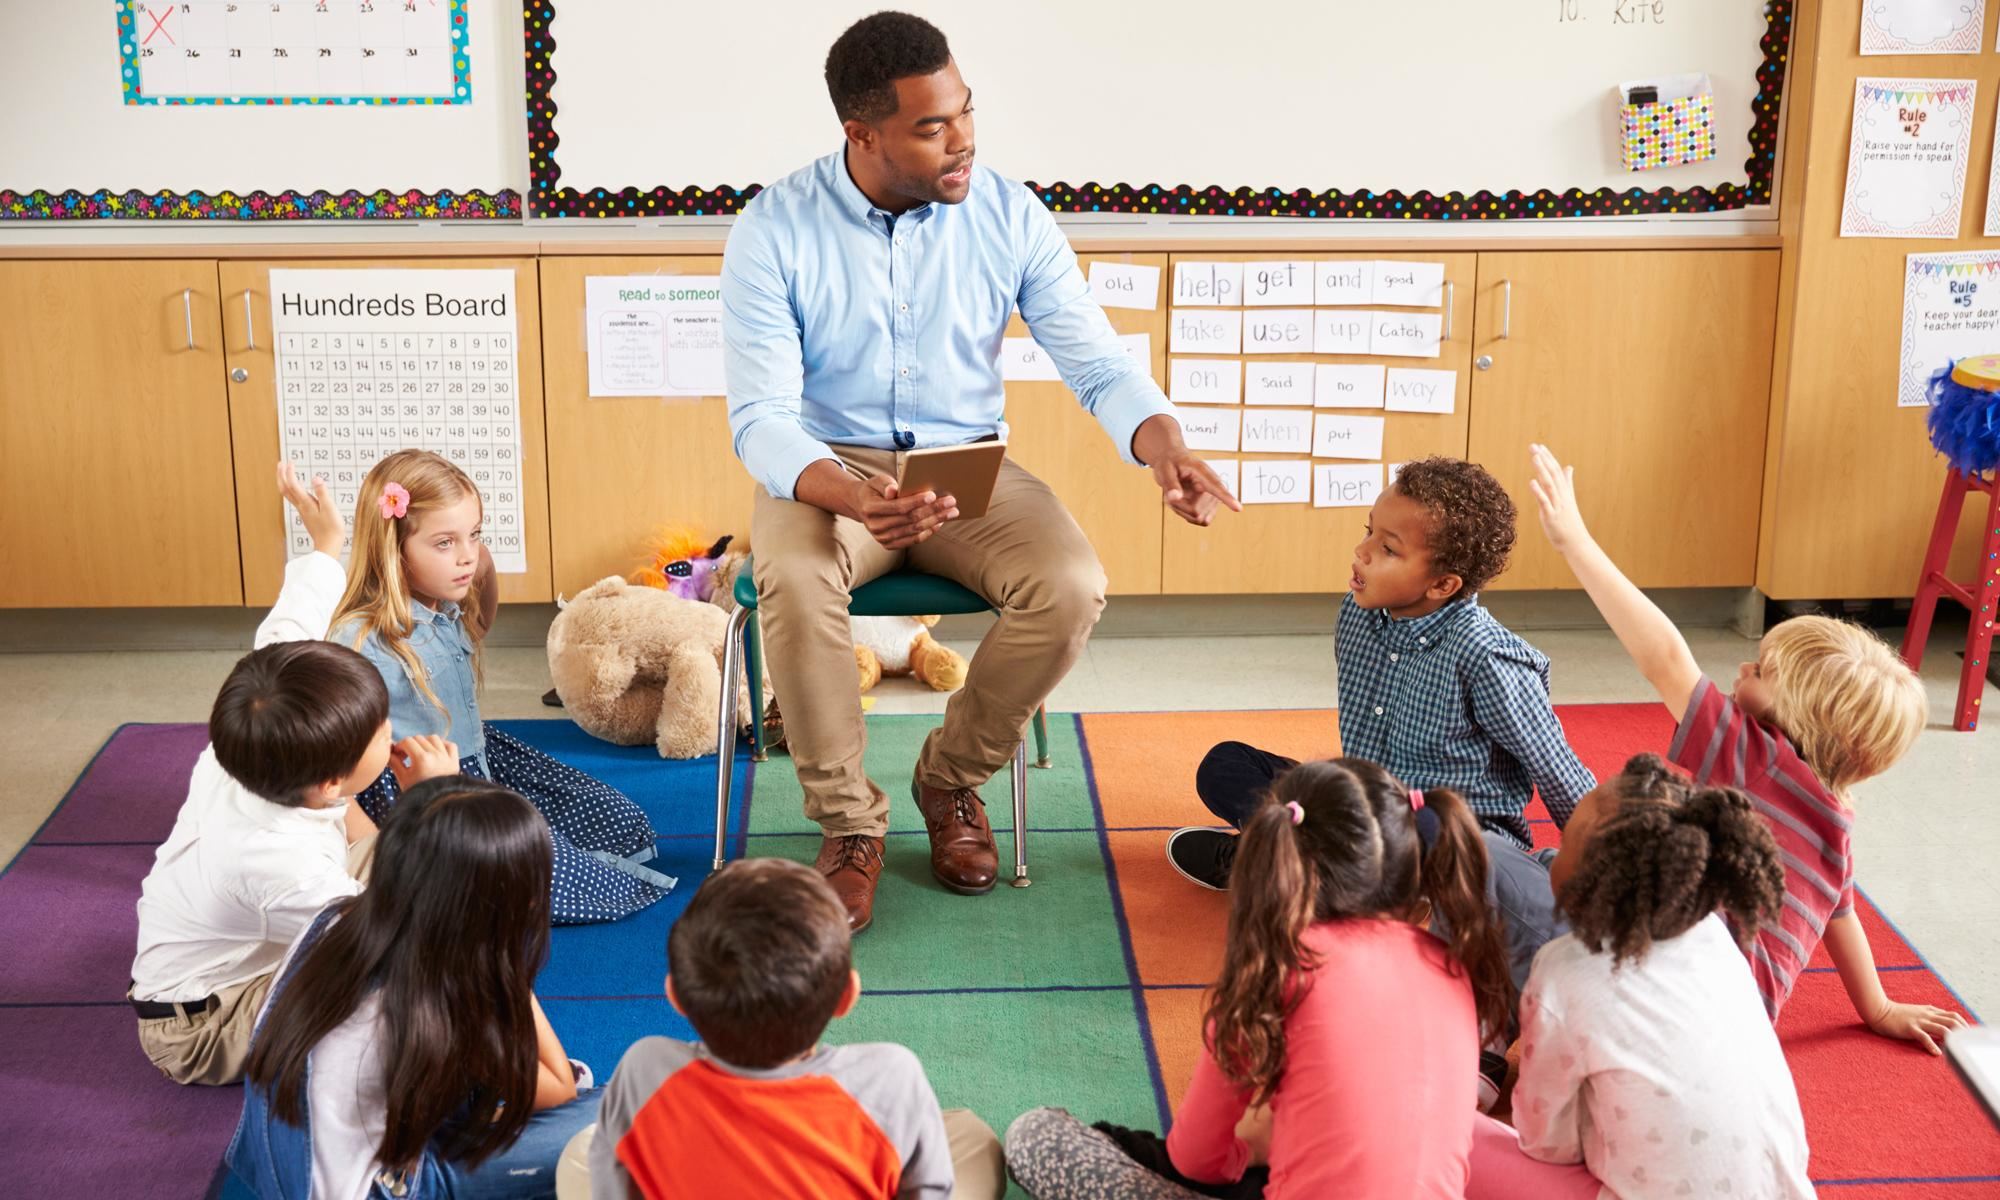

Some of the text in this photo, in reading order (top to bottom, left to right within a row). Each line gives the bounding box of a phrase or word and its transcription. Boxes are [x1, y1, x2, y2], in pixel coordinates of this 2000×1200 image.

[181, 5, 190, 13] 19
[361, 49, 375, 57] 30
[1899, 108, 1927, 122] Rule
[1904, 123, 1920, 137] #2
[1866, 141, 1954, 151] Raise your hand for
[1864, 152, 1952, 162] permission to speak
[1105, 277, 1133, 291] old
[1180, 265, 1231, 304] help
[1256, 263, 1296, 296] get
[1326, 268, 1361, 288] and
[1384, 273, 1414, 287] good
[1950, 281, 1977, 293] Rule
[619, 288, 650, 301] Read
[655, 292, 666, 301] to
[1954, 295, 1972, 307] #5
[282, 293, 506, 316] Hundreds Board
[1924, 308, 1999, 321] Keep your dear
[1178, 319, 1225, 340] take
[1330, 322, 1360, 341] up
[1924, 319, 1999, 331] teacher happy!
[1253, 323, 1300, 342] use
[1379, 327, 1424, 340] Catch
[289, 338, 507, 349] 1 2 3 4 5 6 7 8 9 10
[1022, 352, 1038, 363] of
[288, 360, 508, 371] 11 12 13 14 15 16 17 18 19 20
[1189, 370, 1218, 388] on
[1263, 374, 1292, 389] said
[288, 382, 509, 393] 21 22 23 24 25 26 27 28 29 30
[1337, 381, 1354, 392] no
[1393, 380, 1438, 403] way
[289, 405, 510, 416] 31 32 33 34 35 36 37 38 39 40
[289, 427, 511, 438] 41 42 43 44 45 46 47 48 49 50
[1186, 422, 1218, 434] want
[1246, 418, 1300, 441] when
[1328, 429, 1352, 442] put
[291, 450, 304, 460] 51
[314, 450, 328, 460] 52
[337, 450, 352, 460] 53
[360, 450, 375, 460] 54
[452, 450, 466, 459] 58
[474, 449, 489, 459] 59
[497, 449, 511, 459] 60
[338, 472, 352, 482] 63
[475, 471, 489, 481] 69
[498, 471, 512, 481] 70
[1256, 465, 1295, 496] too
[1328, 470, 1371, 501] her
[340, 493, 354, 503] 73
[499, 493, 513, 503] 80
[499, 514, 514, 525] 90
[296, 537, 310, 546] 91
[498, 536, 518, 546] 100
